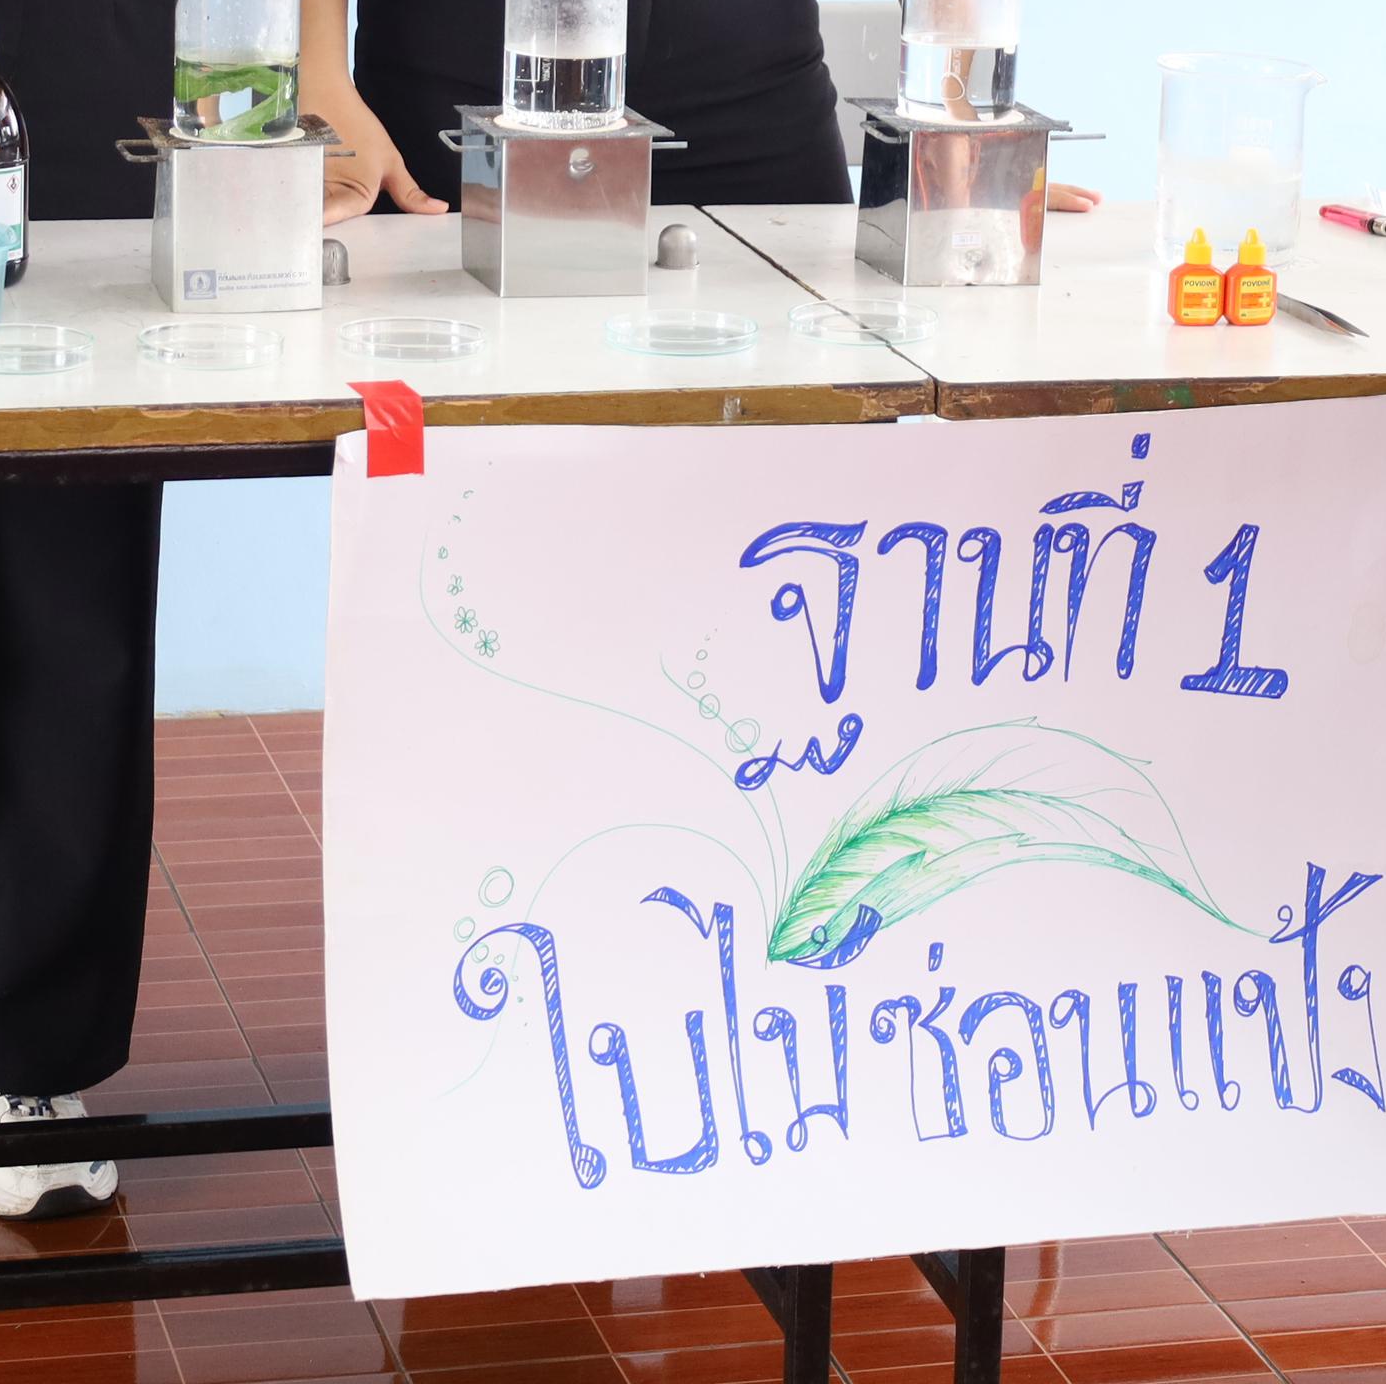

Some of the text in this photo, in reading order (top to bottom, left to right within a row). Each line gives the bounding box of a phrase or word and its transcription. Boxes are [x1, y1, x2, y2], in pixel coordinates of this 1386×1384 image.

[735, 432, 1290, 790] ฐานที่ 1
